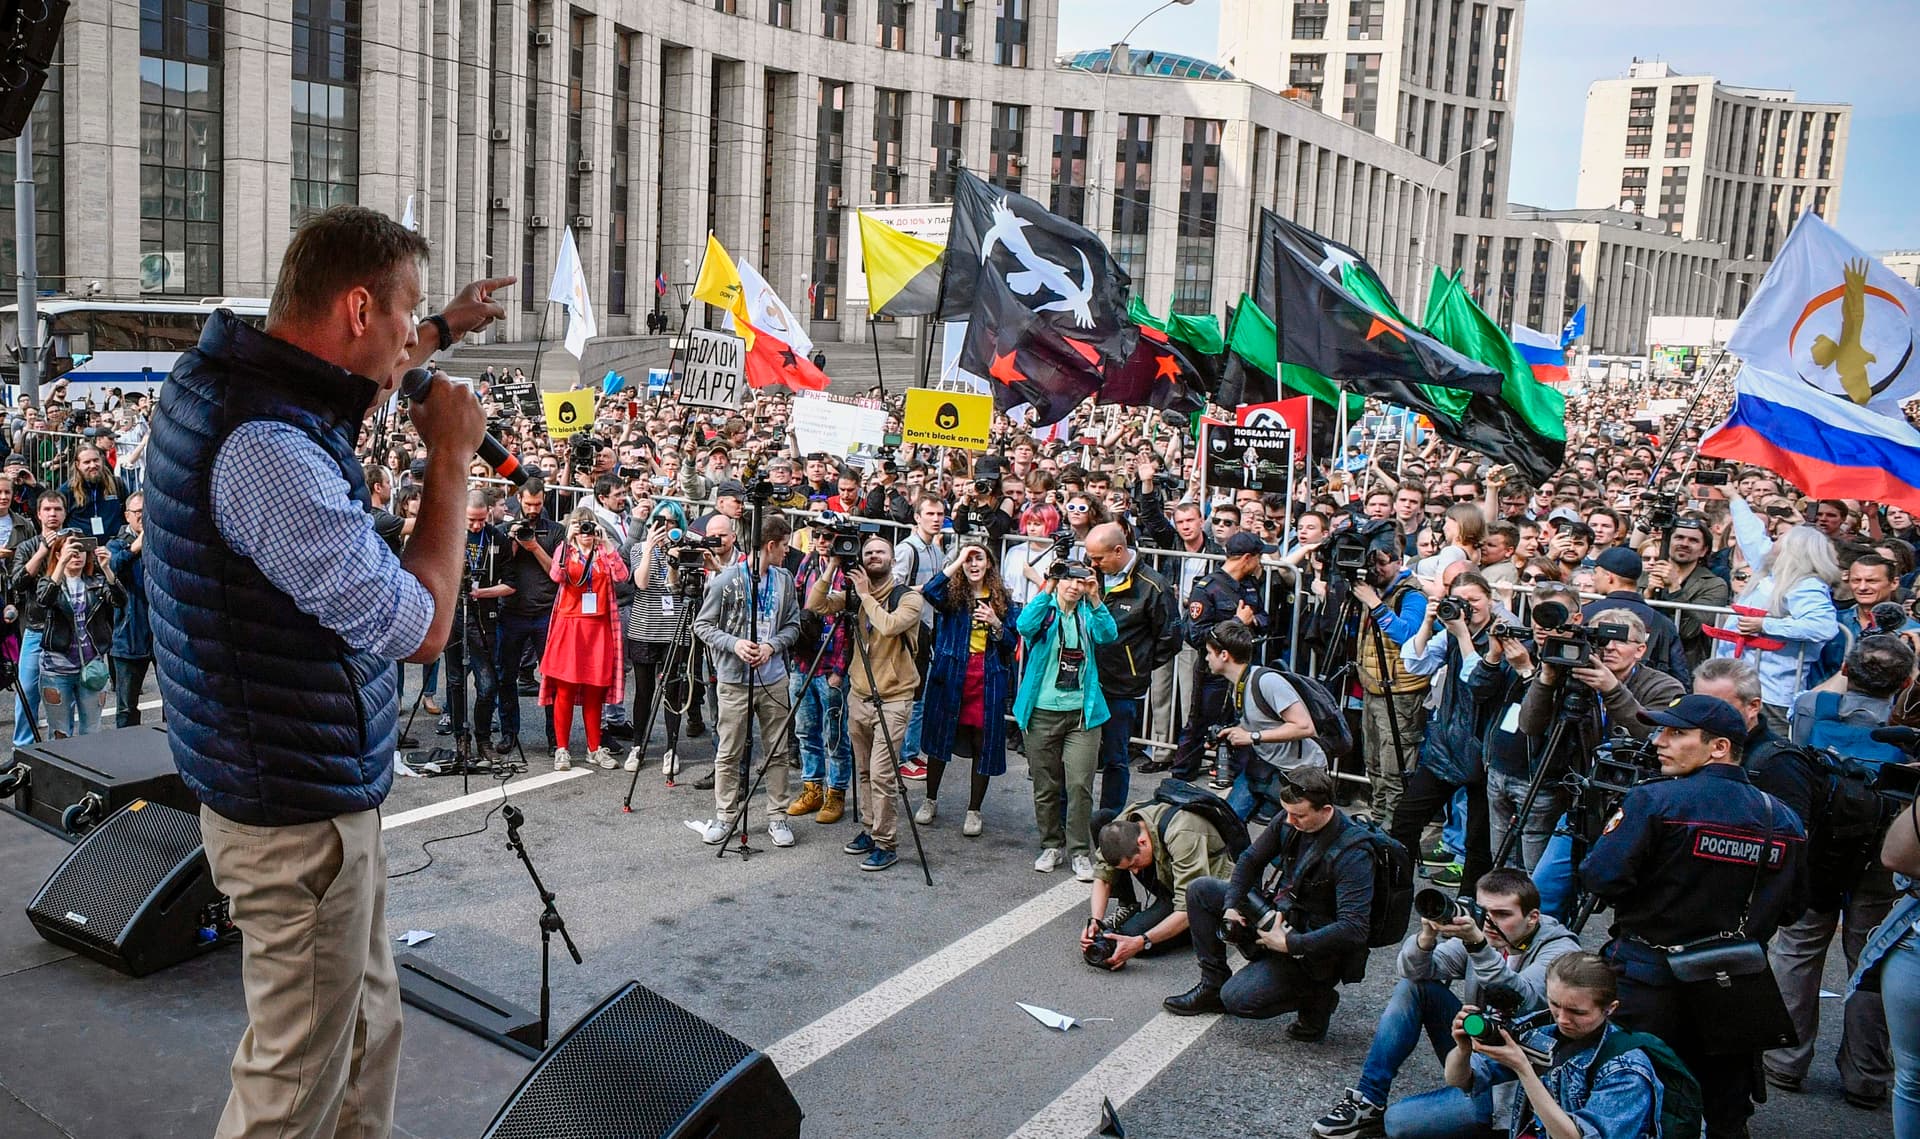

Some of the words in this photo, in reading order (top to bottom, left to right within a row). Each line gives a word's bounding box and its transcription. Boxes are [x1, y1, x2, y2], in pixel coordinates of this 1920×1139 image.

[896, 217, 908, 226] ДО
[910, 217, 925, 225] 10%
[684, 368, 736, 403] ЦАРЯ
[907, 429, 930, 438] Don't
[932, 432, 956, 440] block
[1234, 428, 1268, 437] ПОБЕДА
[1269, 430, 1290, 438] БУДЕ
[1234, 438, 1247, 447] ЗА
[1249, 439, 1284, 449] НАМИ!
[1700, 836, 1780, 863] РОСГВАРДЯ
